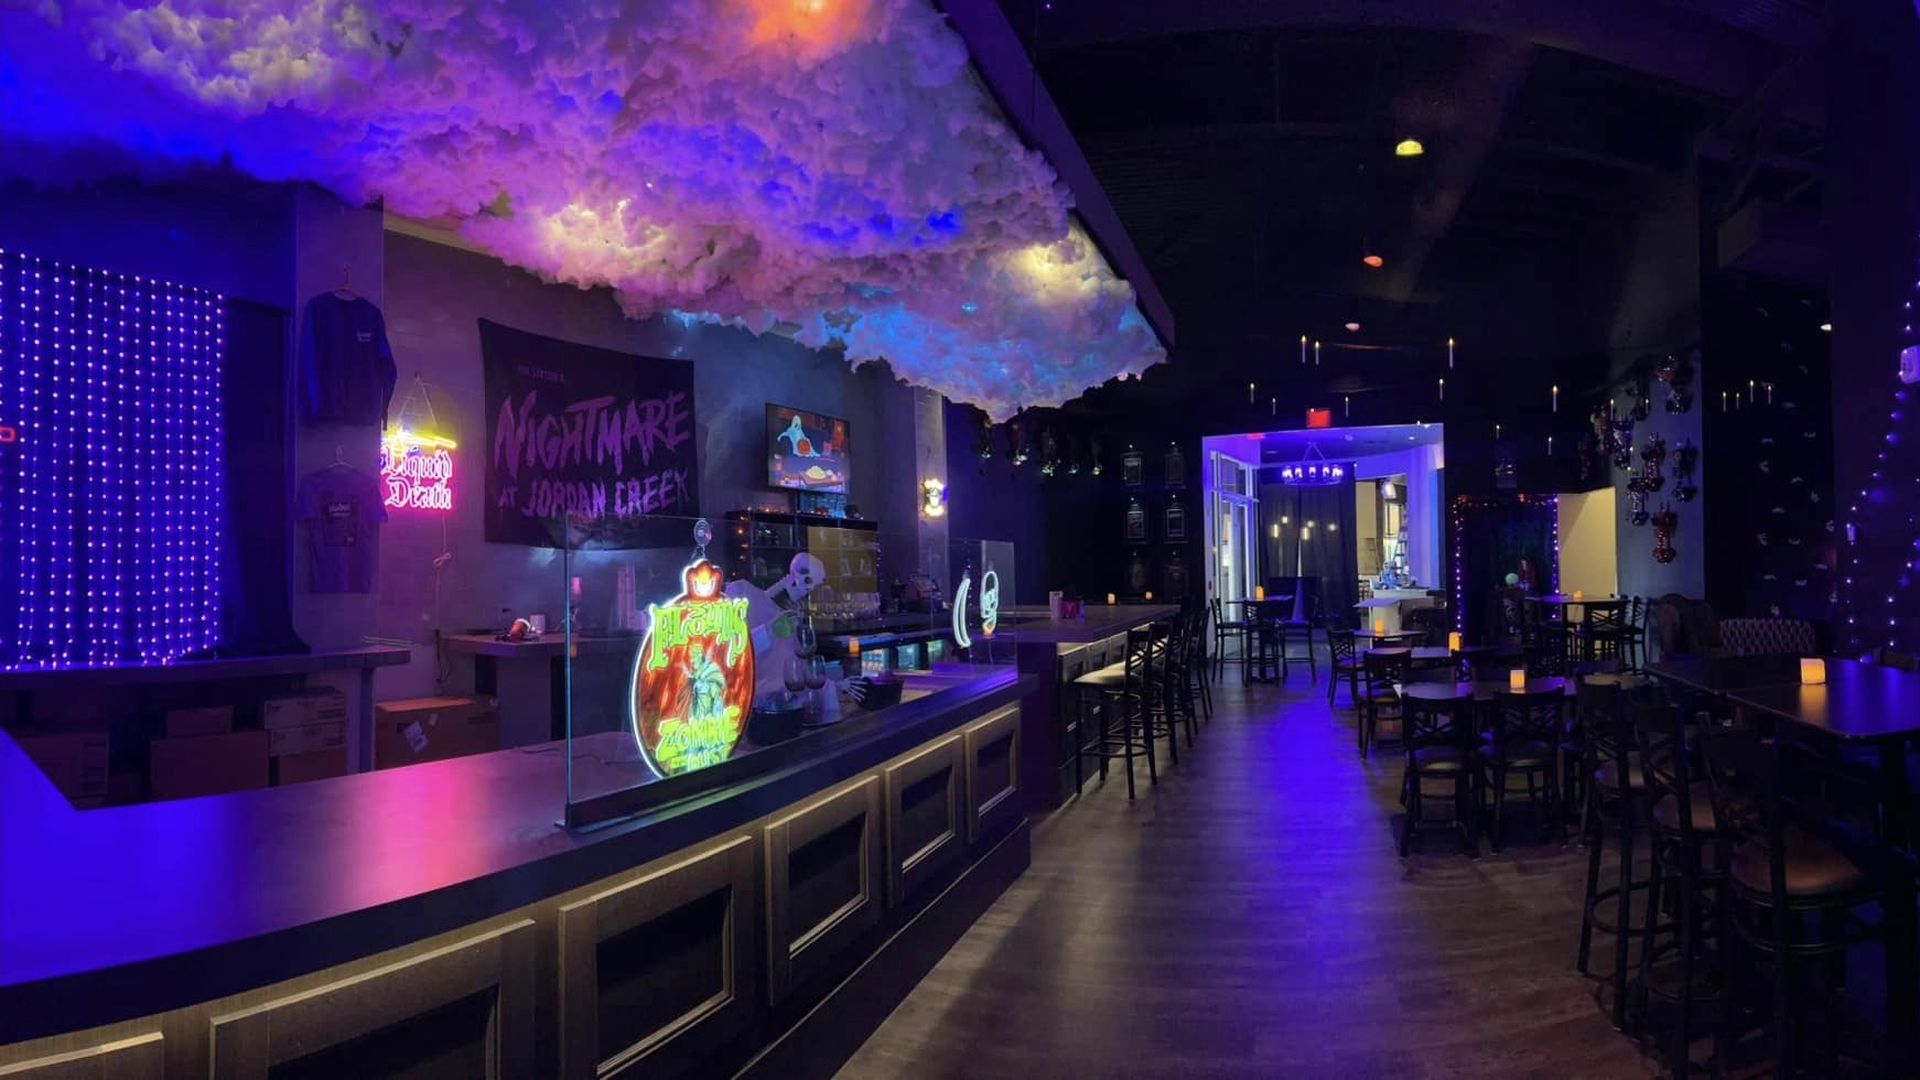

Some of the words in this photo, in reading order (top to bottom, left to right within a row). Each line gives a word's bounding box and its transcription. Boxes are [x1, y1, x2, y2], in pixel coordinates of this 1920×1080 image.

[494, 389, 690, 481] NIGHTMARE
[380, 446, 453, 486] Liquid
[384, 475, 452, 509] Death
[497, 485, 518, 509] AT
[521, 478, 608, 520] JORDAN
[613, 466, 690, 519] CREEK
[656, 705, 740, 762] ZOMBIE
